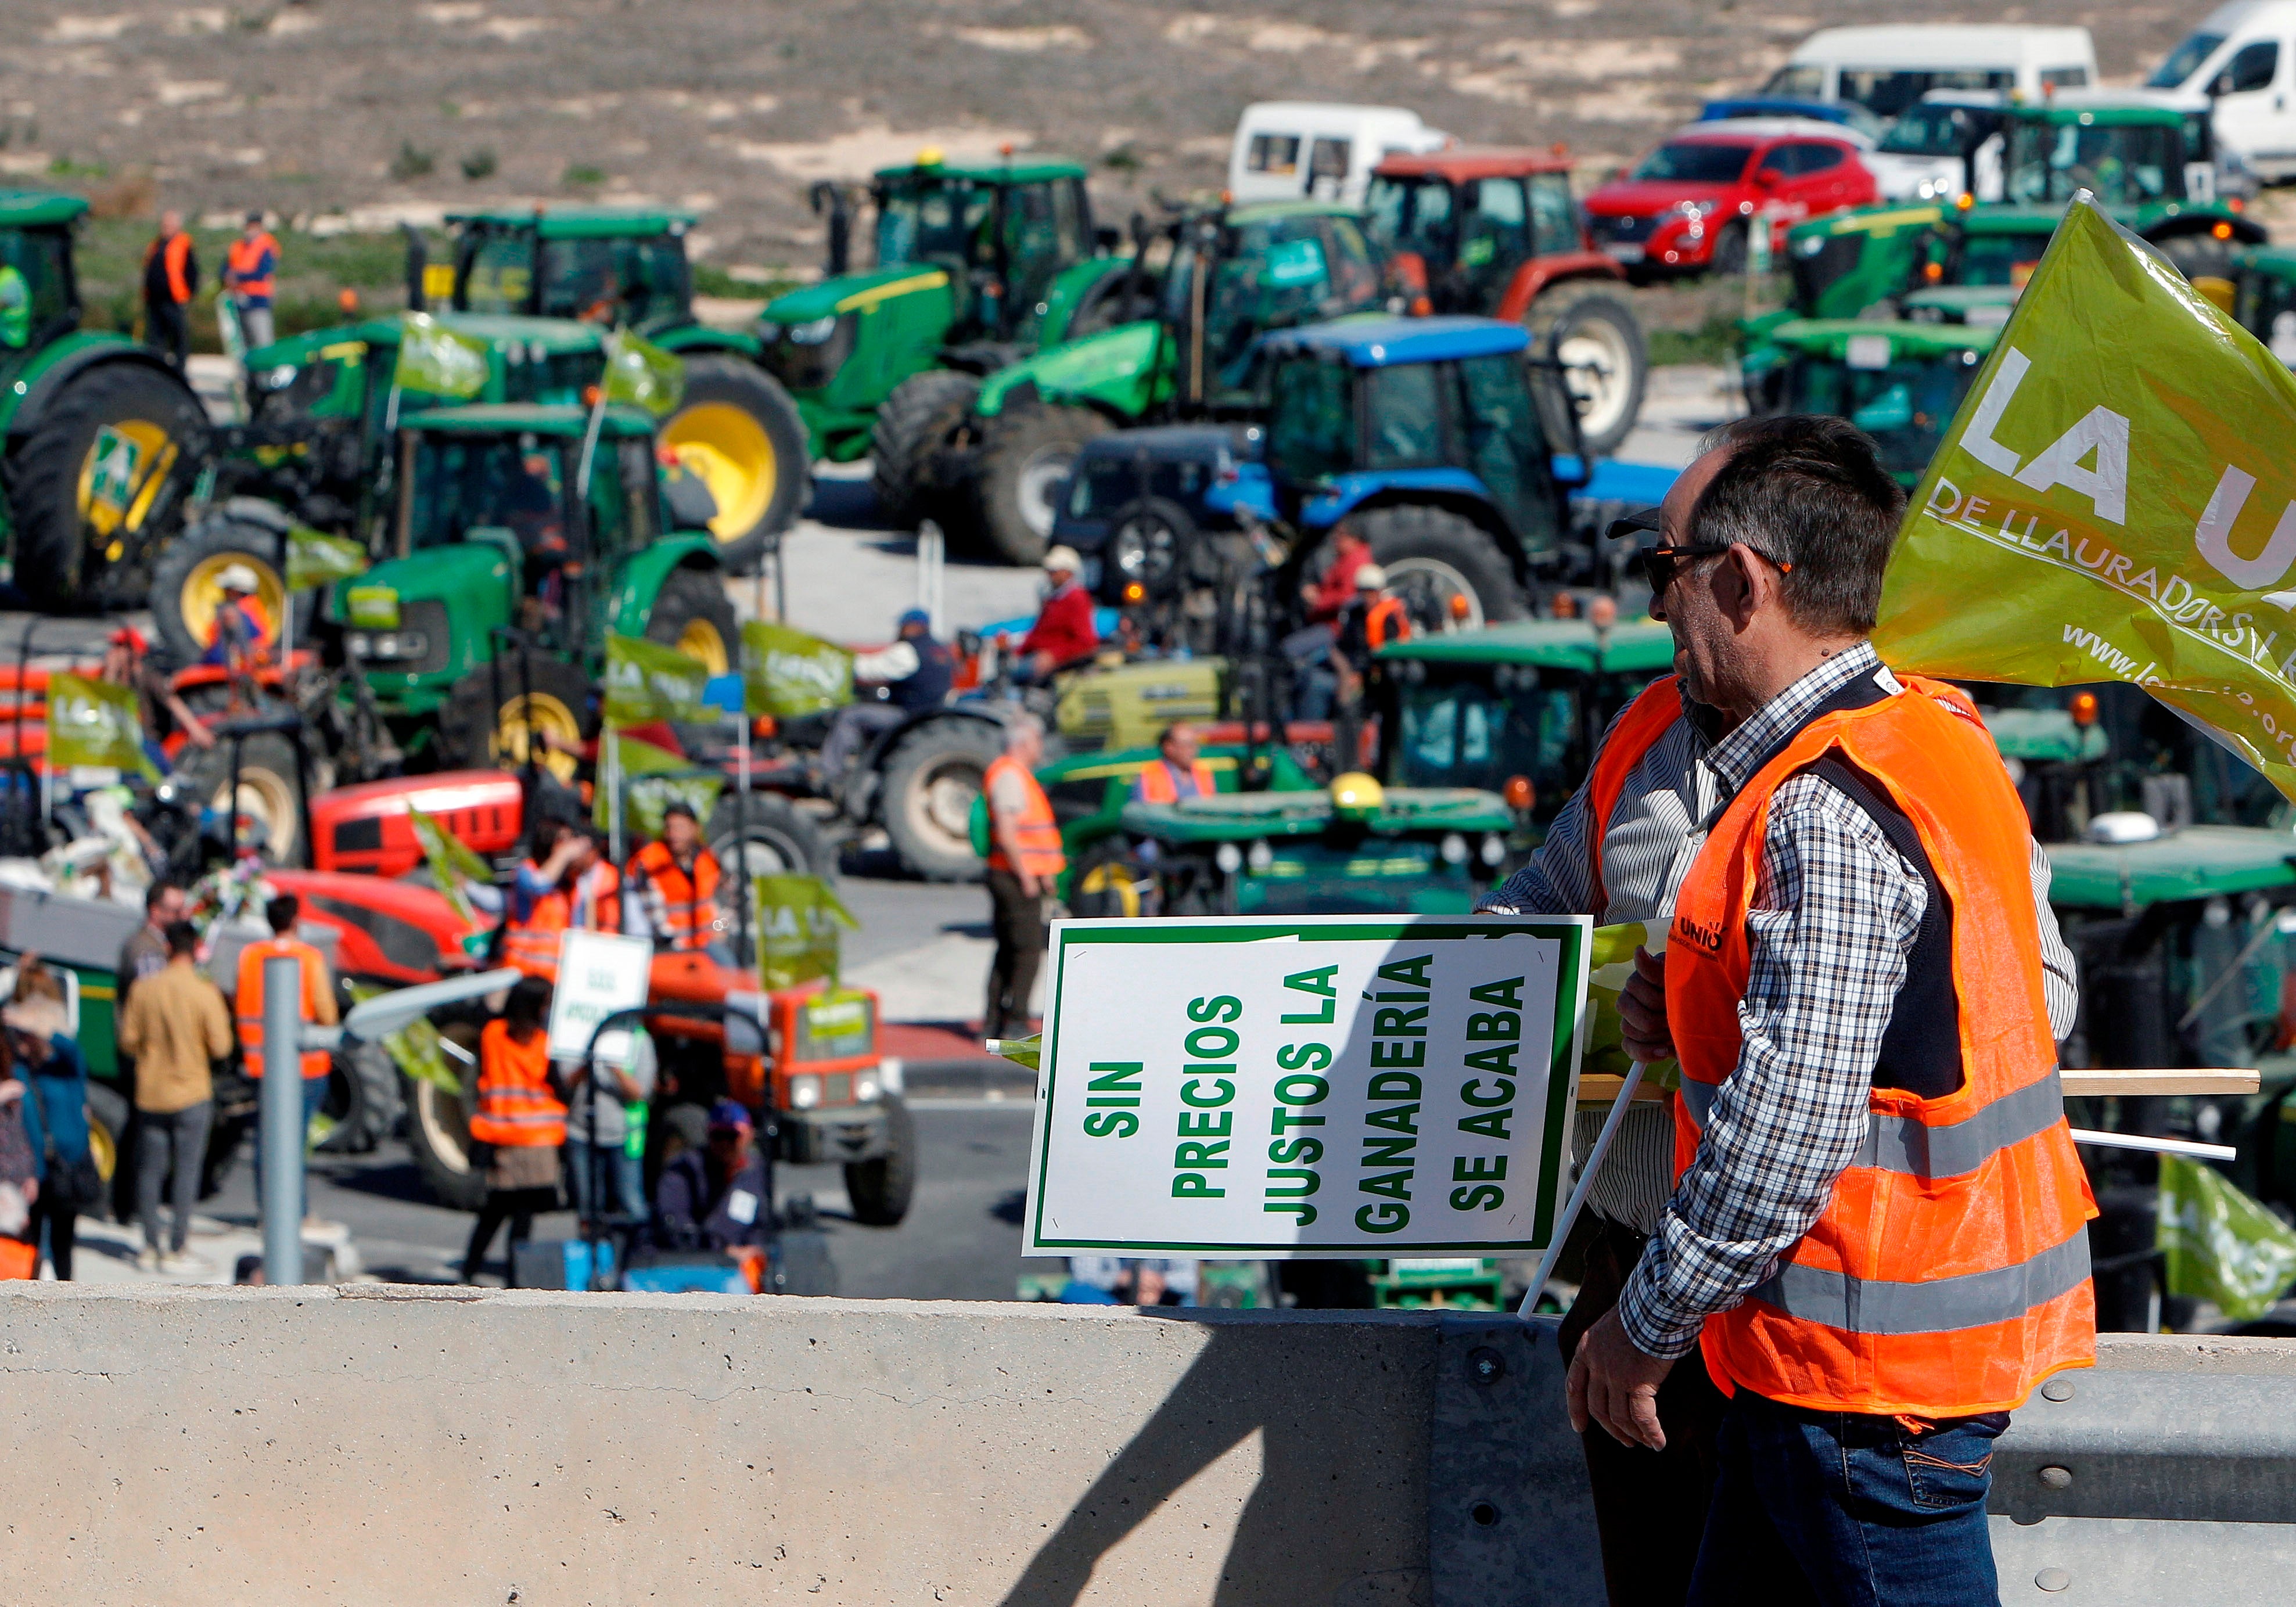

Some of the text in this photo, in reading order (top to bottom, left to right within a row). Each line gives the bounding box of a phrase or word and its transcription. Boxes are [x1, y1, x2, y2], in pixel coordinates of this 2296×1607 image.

[1927, 476, 1991, 527] DE
[1998, 509, 2254, 647] LLAURADORS
[1959, 346, 2296, 613] LA U
[1083, 1062, 1144, 1138] SIN
[1171, 995, 1242, 1198] PRECIOS
[1263, 964, 1339, 1227] JUSTOS LA
[1354, 953, 1434, 1234] GANADERÍA
[1449, 975, 1525, 1212] SE ACABA
